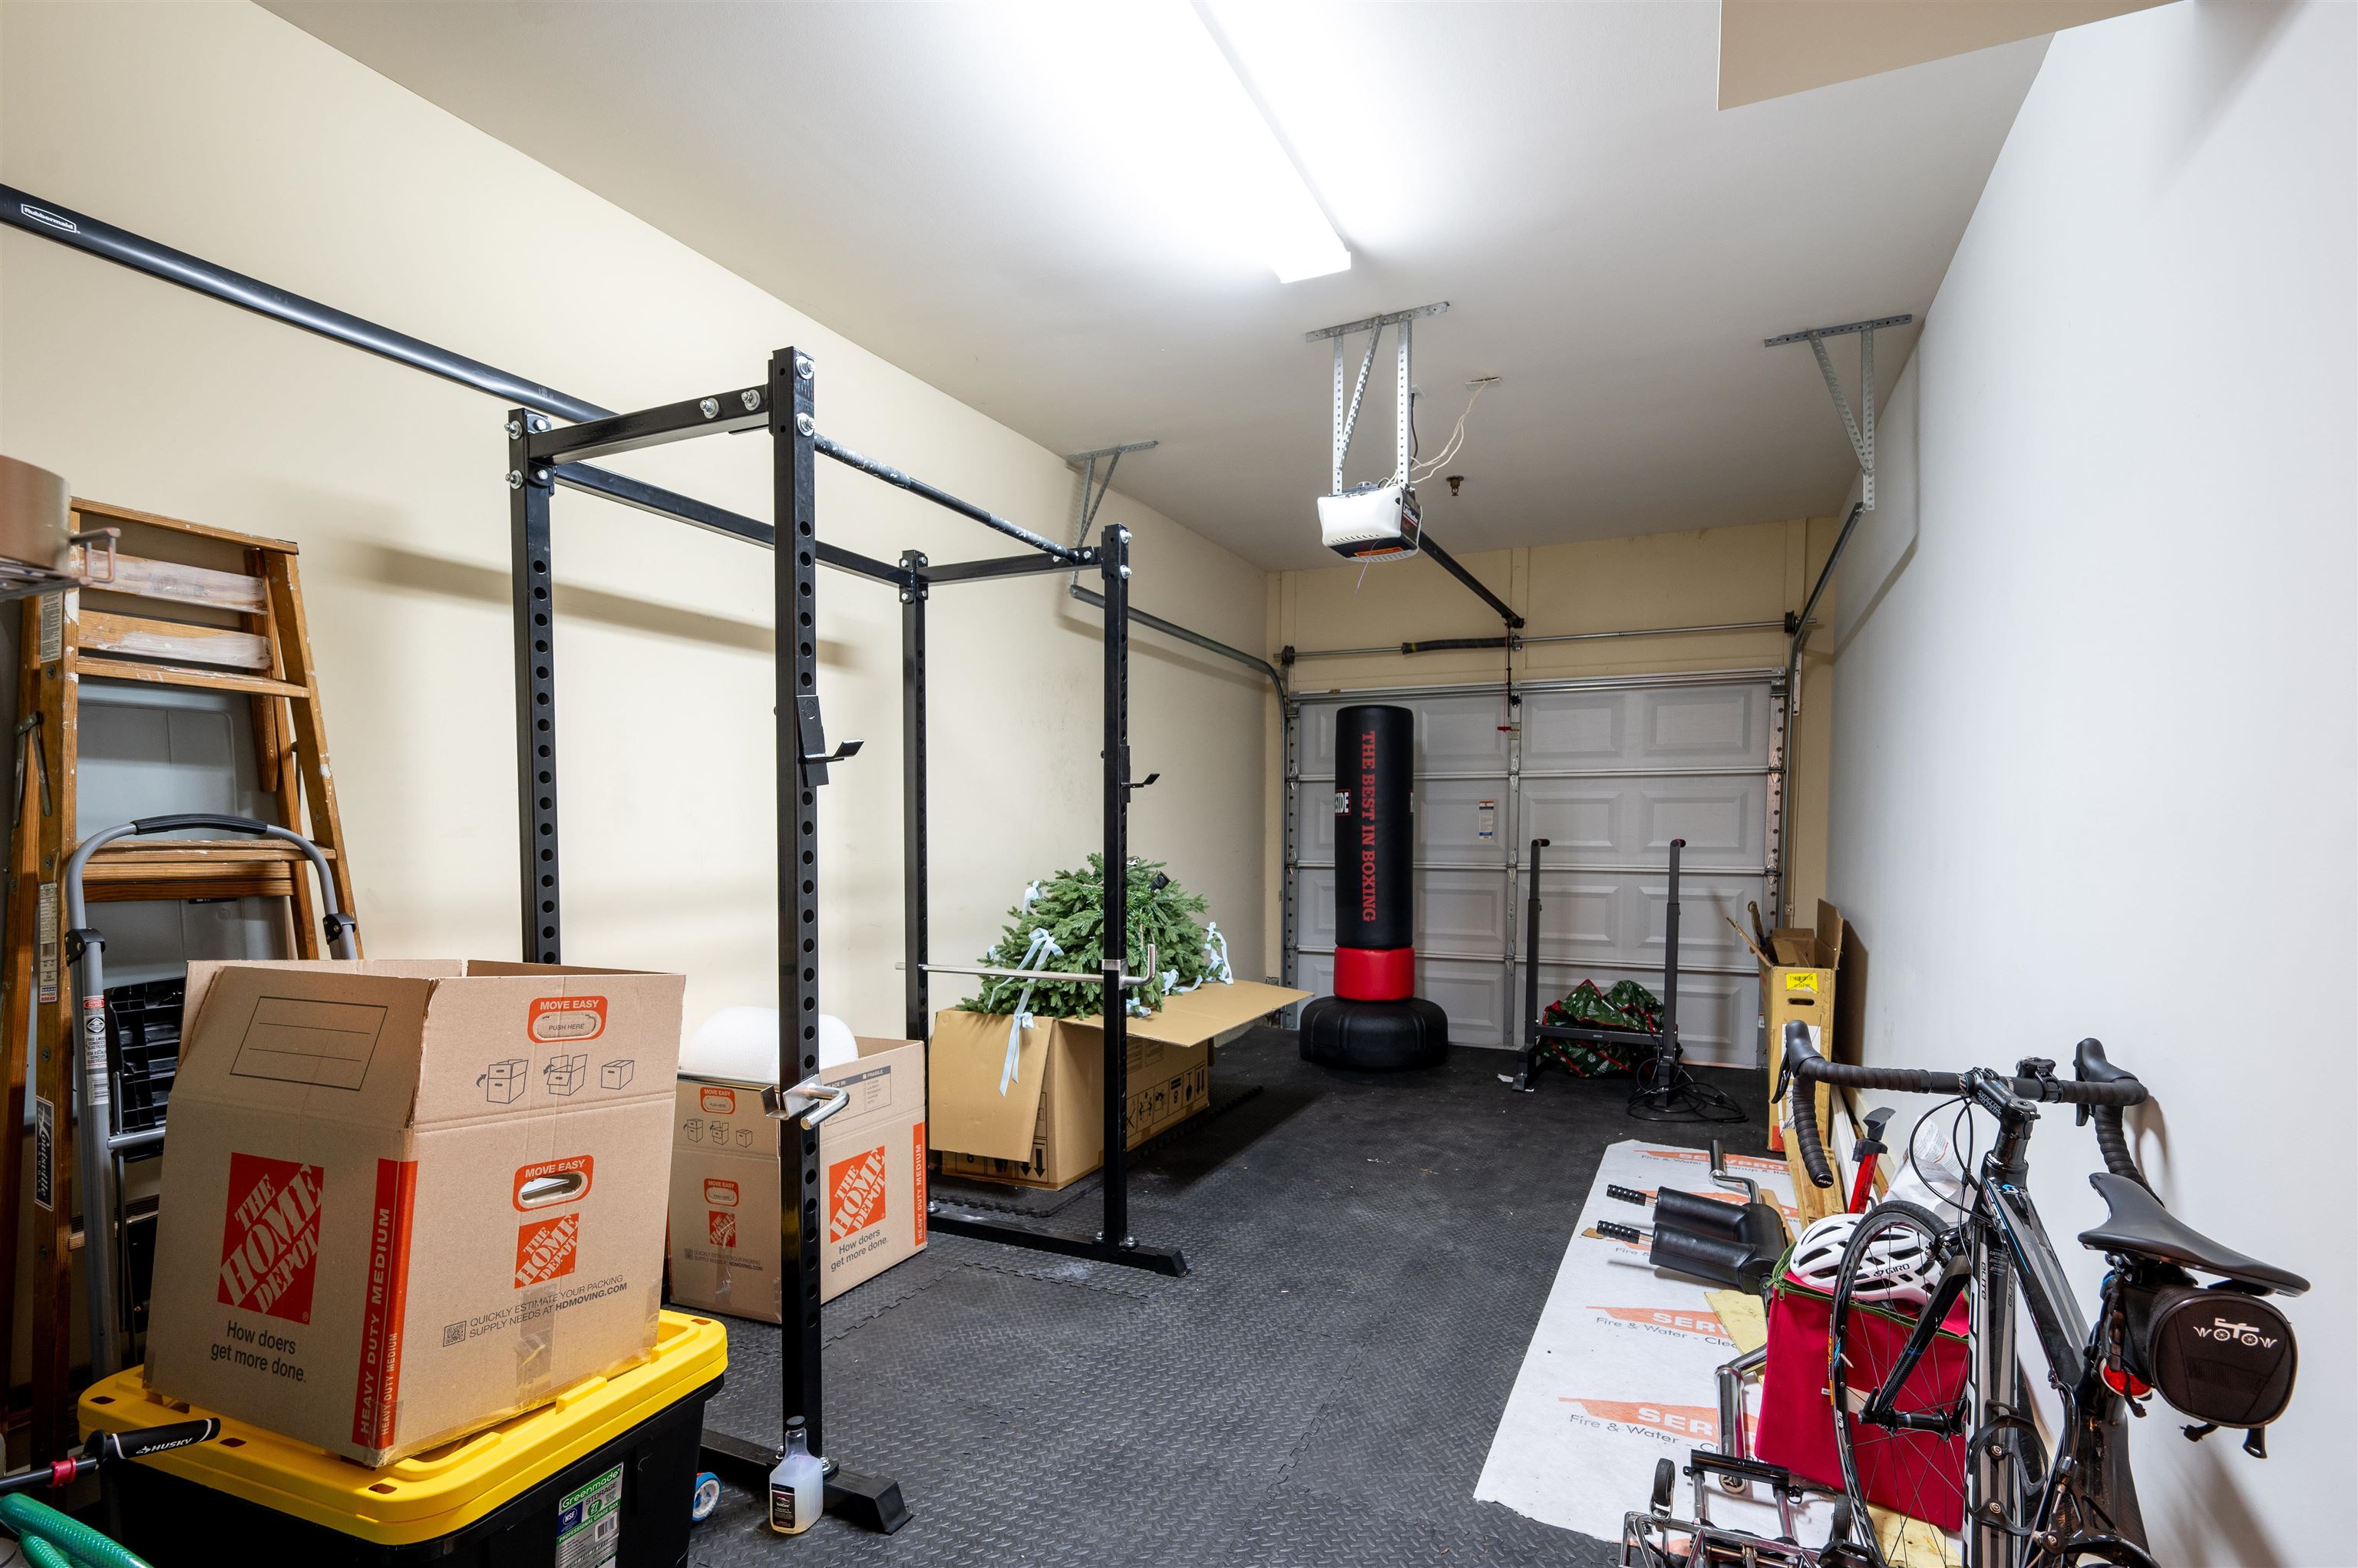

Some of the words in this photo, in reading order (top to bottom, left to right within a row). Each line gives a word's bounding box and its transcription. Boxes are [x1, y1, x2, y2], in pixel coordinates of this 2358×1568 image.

[24, 206, 74, 229] Rubbermaid
[1362, 730, 1376, 769] THE
[1362, 773, 1376, 820] BEST
[1362, 824, 1376, 846] IN
[1362, 850, 1376, 921] BOXING
[540, 1000, 570, 1010] MOVE
[573, 999, 599, 1009] EASY
[524, 1164, 556, 1178] MOVE
[558, 1159, 586, 1172] EASY
[1678, 1154, 1784, 1171] SEVPRO
[831, 1148, 886, 1238] HOME
[835, 1165, 859, 1200] THE
[233, 1173, 277, 1232] THE
[853, 1174, 885, 1230] DEPOT
[219, 1164, 323, 1306] HOME
[515, 1214, 580, 1286] HOME
[523, 1226, 550, 1255] THE
[839, 1241, 857, 1255] How
[859, 1229, 880, 1245] doers
[253, 1223, 319, 1315] DEPOT
[372, 1208, 391, 1306] MEDIUM
[539, 1236, 577, 1281] DEPOT
[831, 1259, 845, 1273] get
[846, 1247, 867, 1264] more
[1885, 1263, 1910, 1275] GIRO
[469, 1319, 507, 1339] SUPPLY
[509, 1309, 541, 1325] NEEDS
[542, 1305, 554, 1315] AT
[555, 1282, 627, 1312] HDMOVING.COM
[470, 1308, 513, 1327] QUICKLY
[514, 1293, 559, 1314] ESTIMATE
[560, 1286, 586, 1300] YOUR
[586, 1275, 623, 1292] PACKING
[226, 1319, 256, 1345] How
[258, 1329, 296, 1355] doers
[367, 1312, 380, 1365] DUTY
[1596, 1317, 1622, 1327] Fire
[1644, 1325, 1689, 1339] Water
[1652, 1312, 1729, 1335] SERV
[210, 1342, 233, 1362] get
[234, 1349, 268, 1372] more
[387, 1332, 398, 1372] MEDIUM
[360, 1371, 375, 1434] HEAVY
[384, 1373, 394, 1401] DUTY
[381, 1401, 391, 1436] HEAVY
[1570, 1414, 1600, 1428] Fire
[1607, 1423, 1620, 1432] &
[1626, 1424, 1679, 1444] Water
[151, 1438, 193, 1452] HUSKY
[562, 1470, 619, 1508] Greenmade
[586, 1481, 617, 1505] STORAGE
[590, 1500, 599, 1513] 27
[559, 1518, 593, 1543] PROFESSIONAL
[594, 1508, 609, 1521] GRADE
[609, 1501, 619, 1510] BOX
[564, 1510, 575, 1523] NSF
